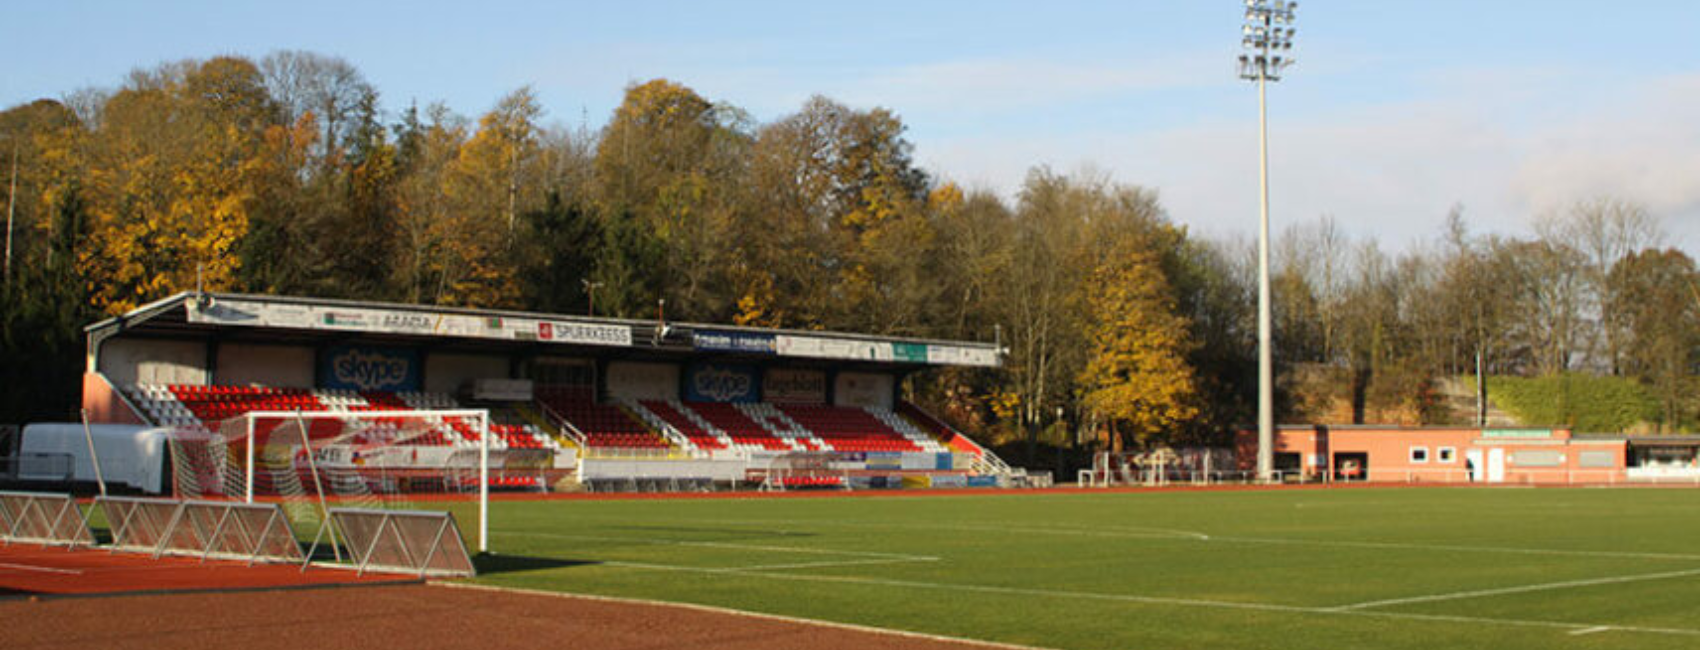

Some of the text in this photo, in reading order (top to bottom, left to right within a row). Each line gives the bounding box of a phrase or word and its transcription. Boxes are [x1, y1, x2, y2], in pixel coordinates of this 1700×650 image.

[555, 324, 628, 343] SPUERKEESS
[337, 351, 405, 386] skype
[697, 368, 749, 397] skype
